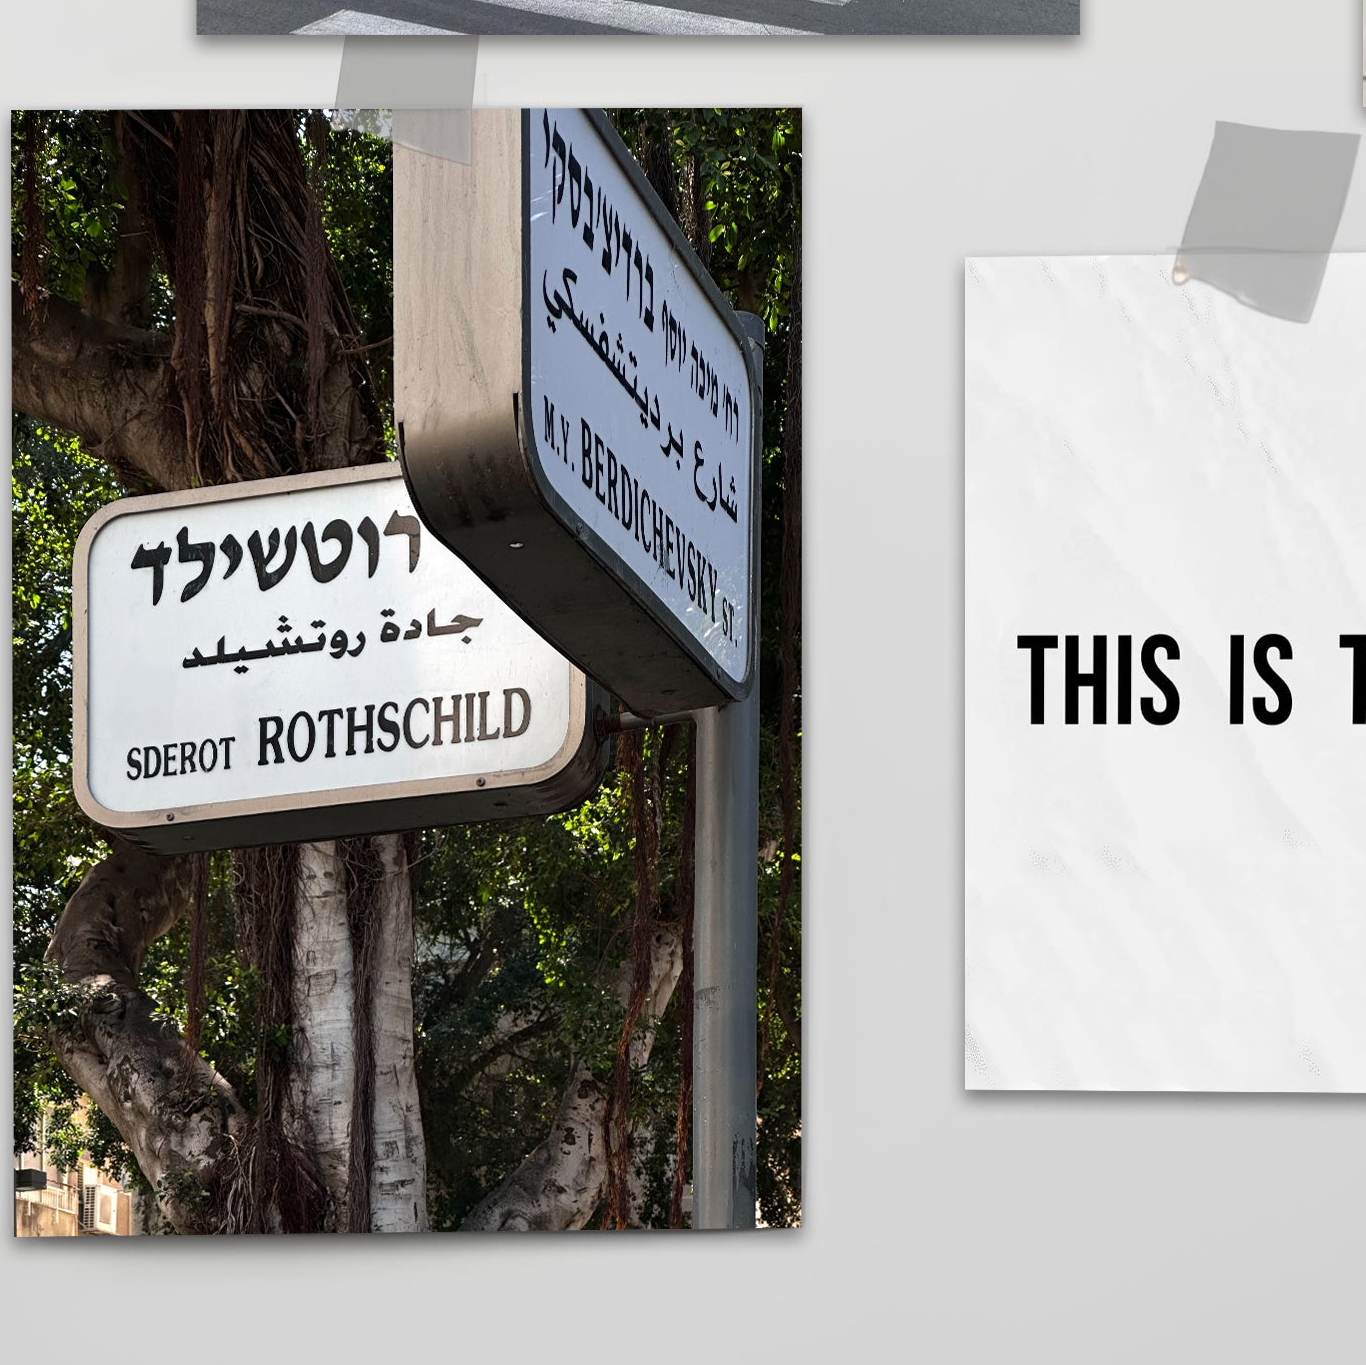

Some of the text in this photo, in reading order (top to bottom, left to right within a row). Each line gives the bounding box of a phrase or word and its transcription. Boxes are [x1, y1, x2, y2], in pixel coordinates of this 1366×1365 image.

[662, 299, 686, 373] יוסף
[690, 340, 719, 418] מיכה
[693, 440, 738, 524] شارع
[130, 510, 422, 606] רוטשילד
[581, 417, 718, 624] BERDICHEVSKY
[722, 596, 738, 648] ST.
[182, 607, 484, 675] جادة روتشيلد
[1017, 632, 1181, 726] THIS
[1228, 632, 1294, 726] IS
[126, 686, 532, 782] SDEROT ROTHSCHILD
